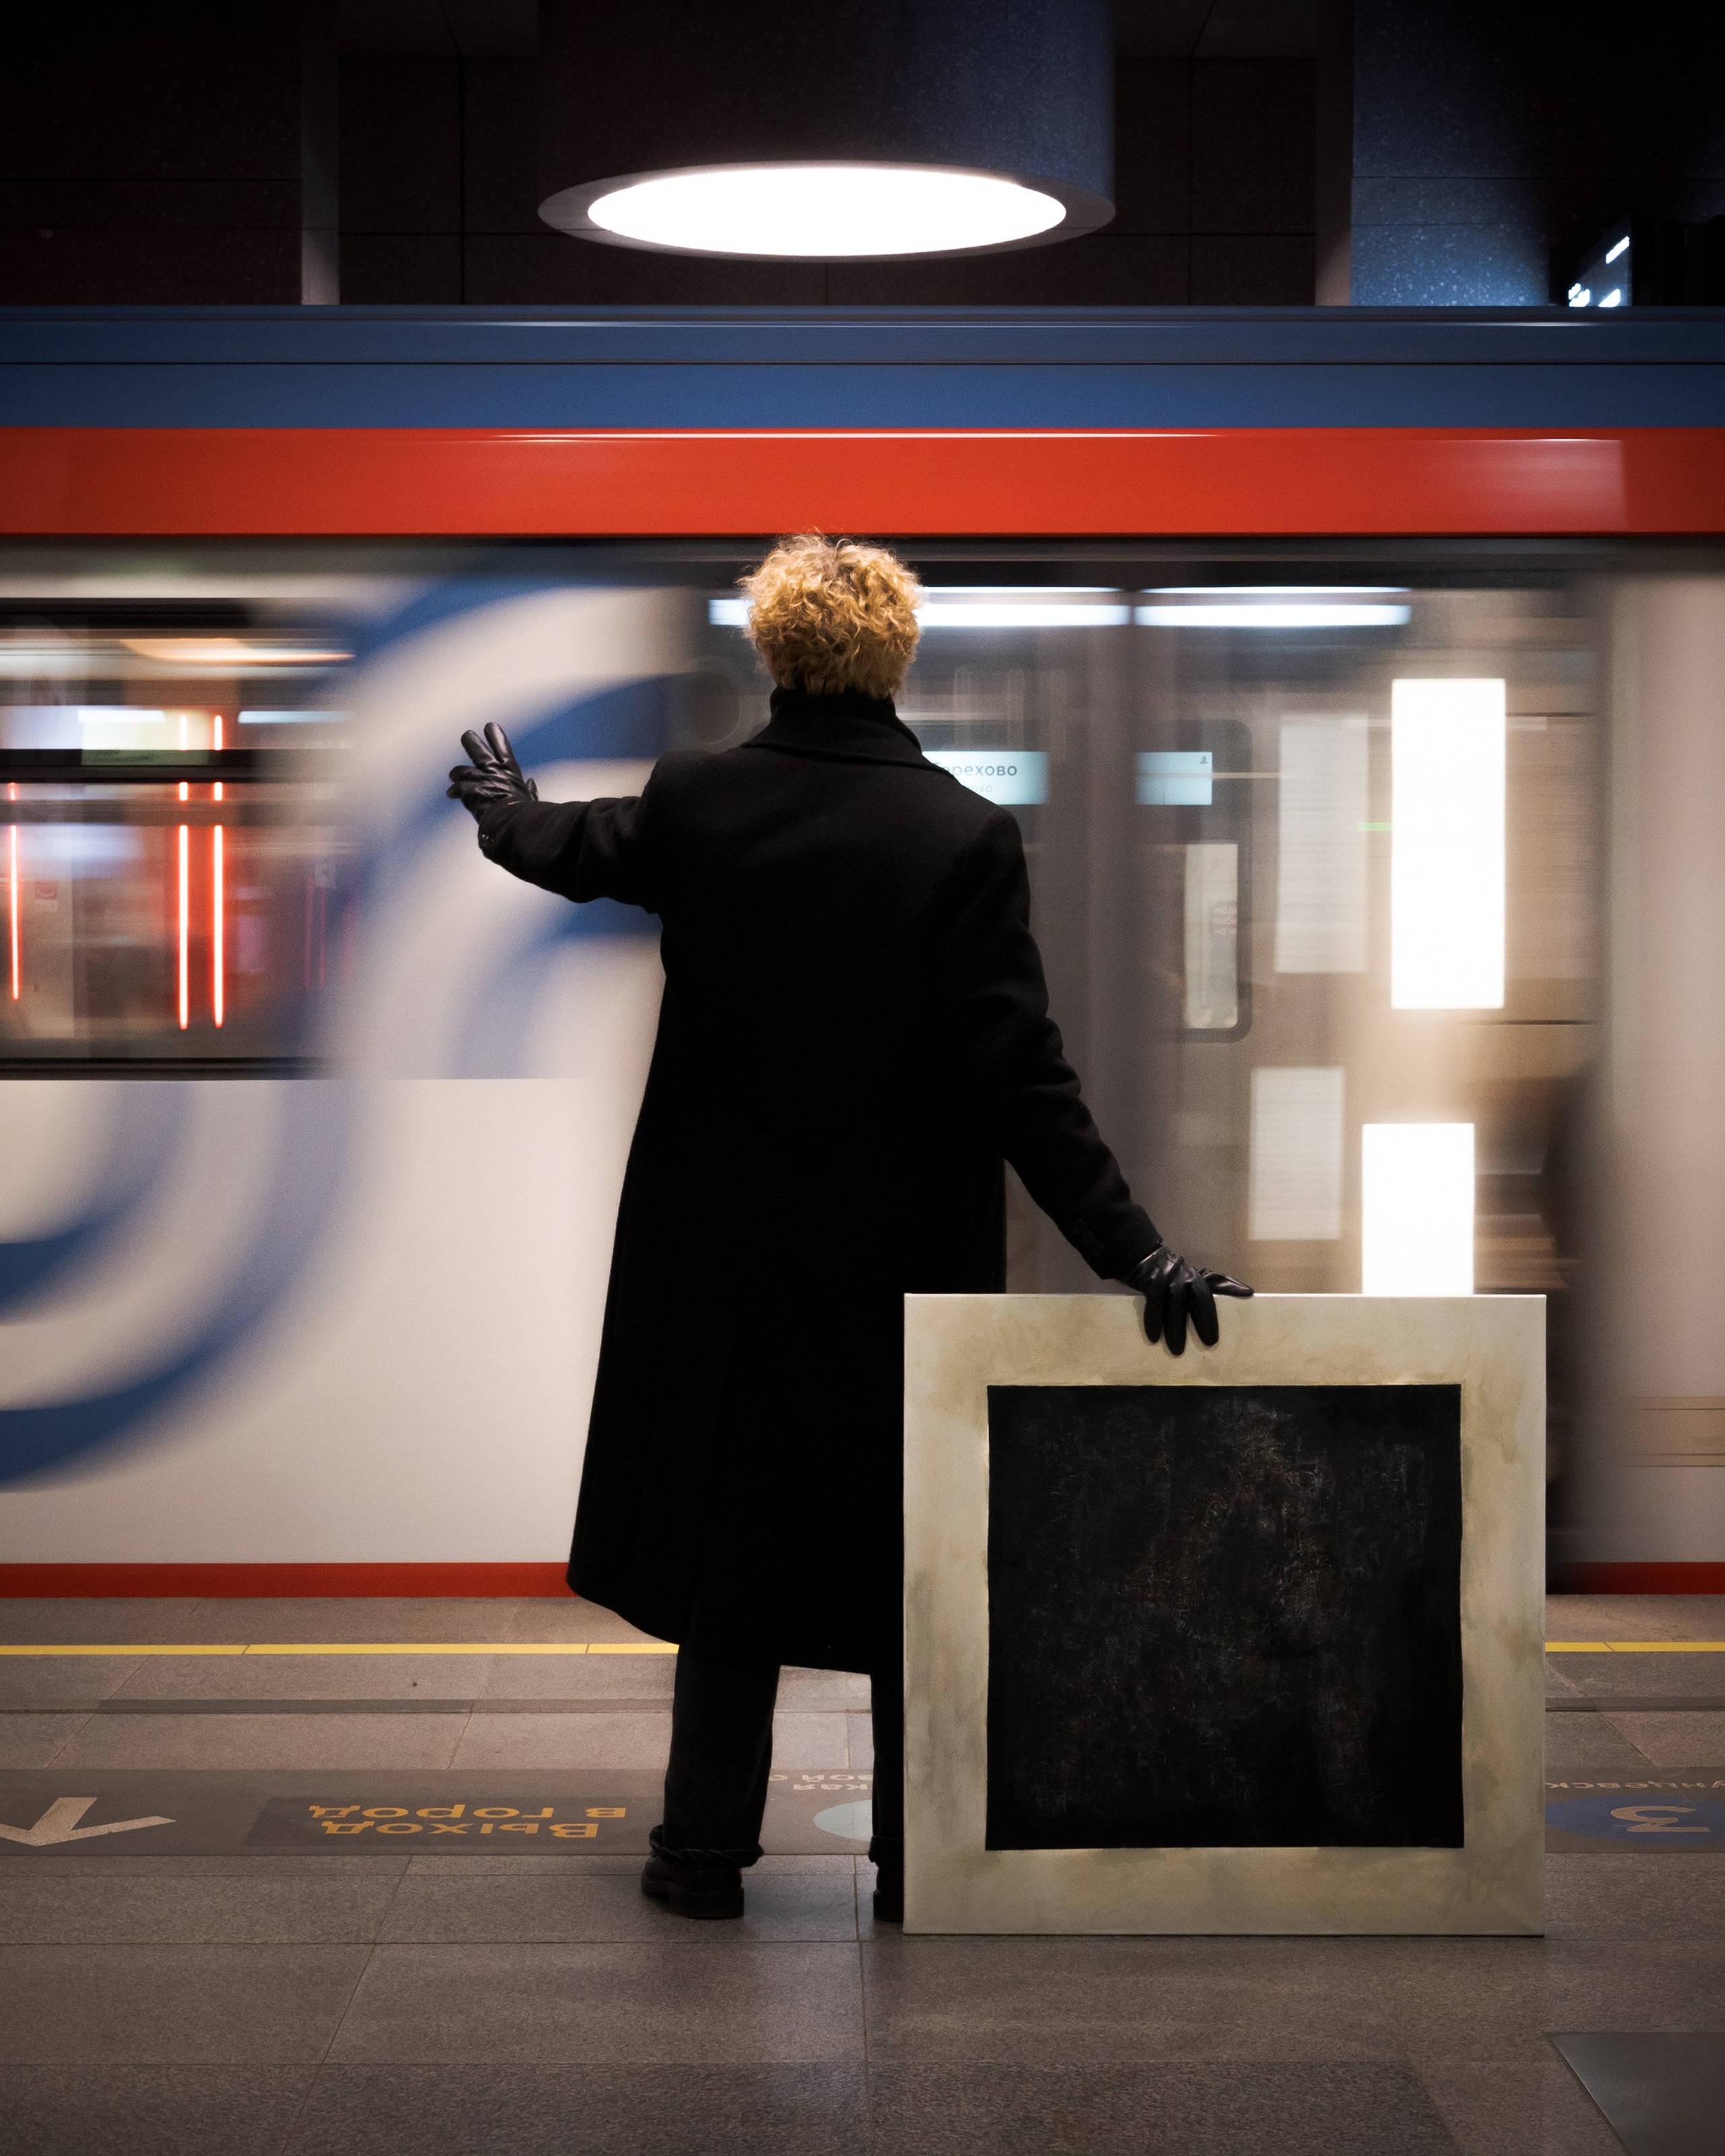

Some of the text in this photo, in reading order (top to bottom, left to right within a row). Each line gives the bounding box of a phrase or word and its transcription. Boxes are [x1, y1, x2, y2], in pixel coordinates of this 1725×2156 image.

[309, 1804, 627, 1818] в город
[1610, 1805, 1710, 1833] 3
[321, 1820, 600, 1839] Выход
